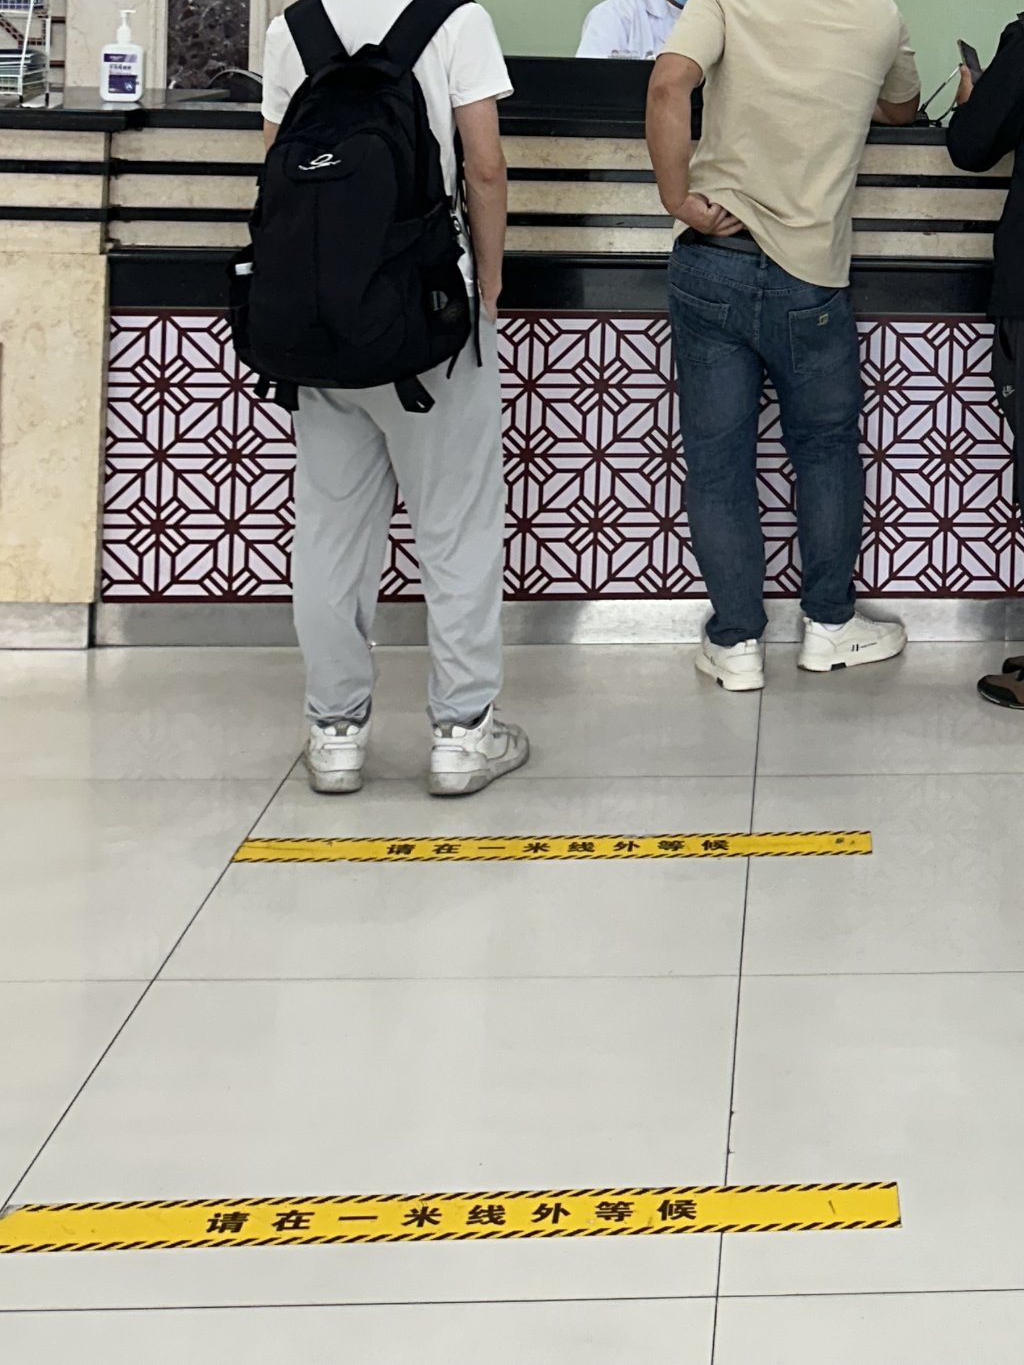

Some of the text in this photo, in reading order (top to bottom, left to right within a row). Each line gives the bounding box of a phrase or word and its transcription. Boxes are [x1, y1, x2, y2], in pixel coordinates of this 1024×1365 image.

[386, 838, 730, 856] 请在一米线外等候
[206, 1199, 698, 1234] 请在一米线外等候
